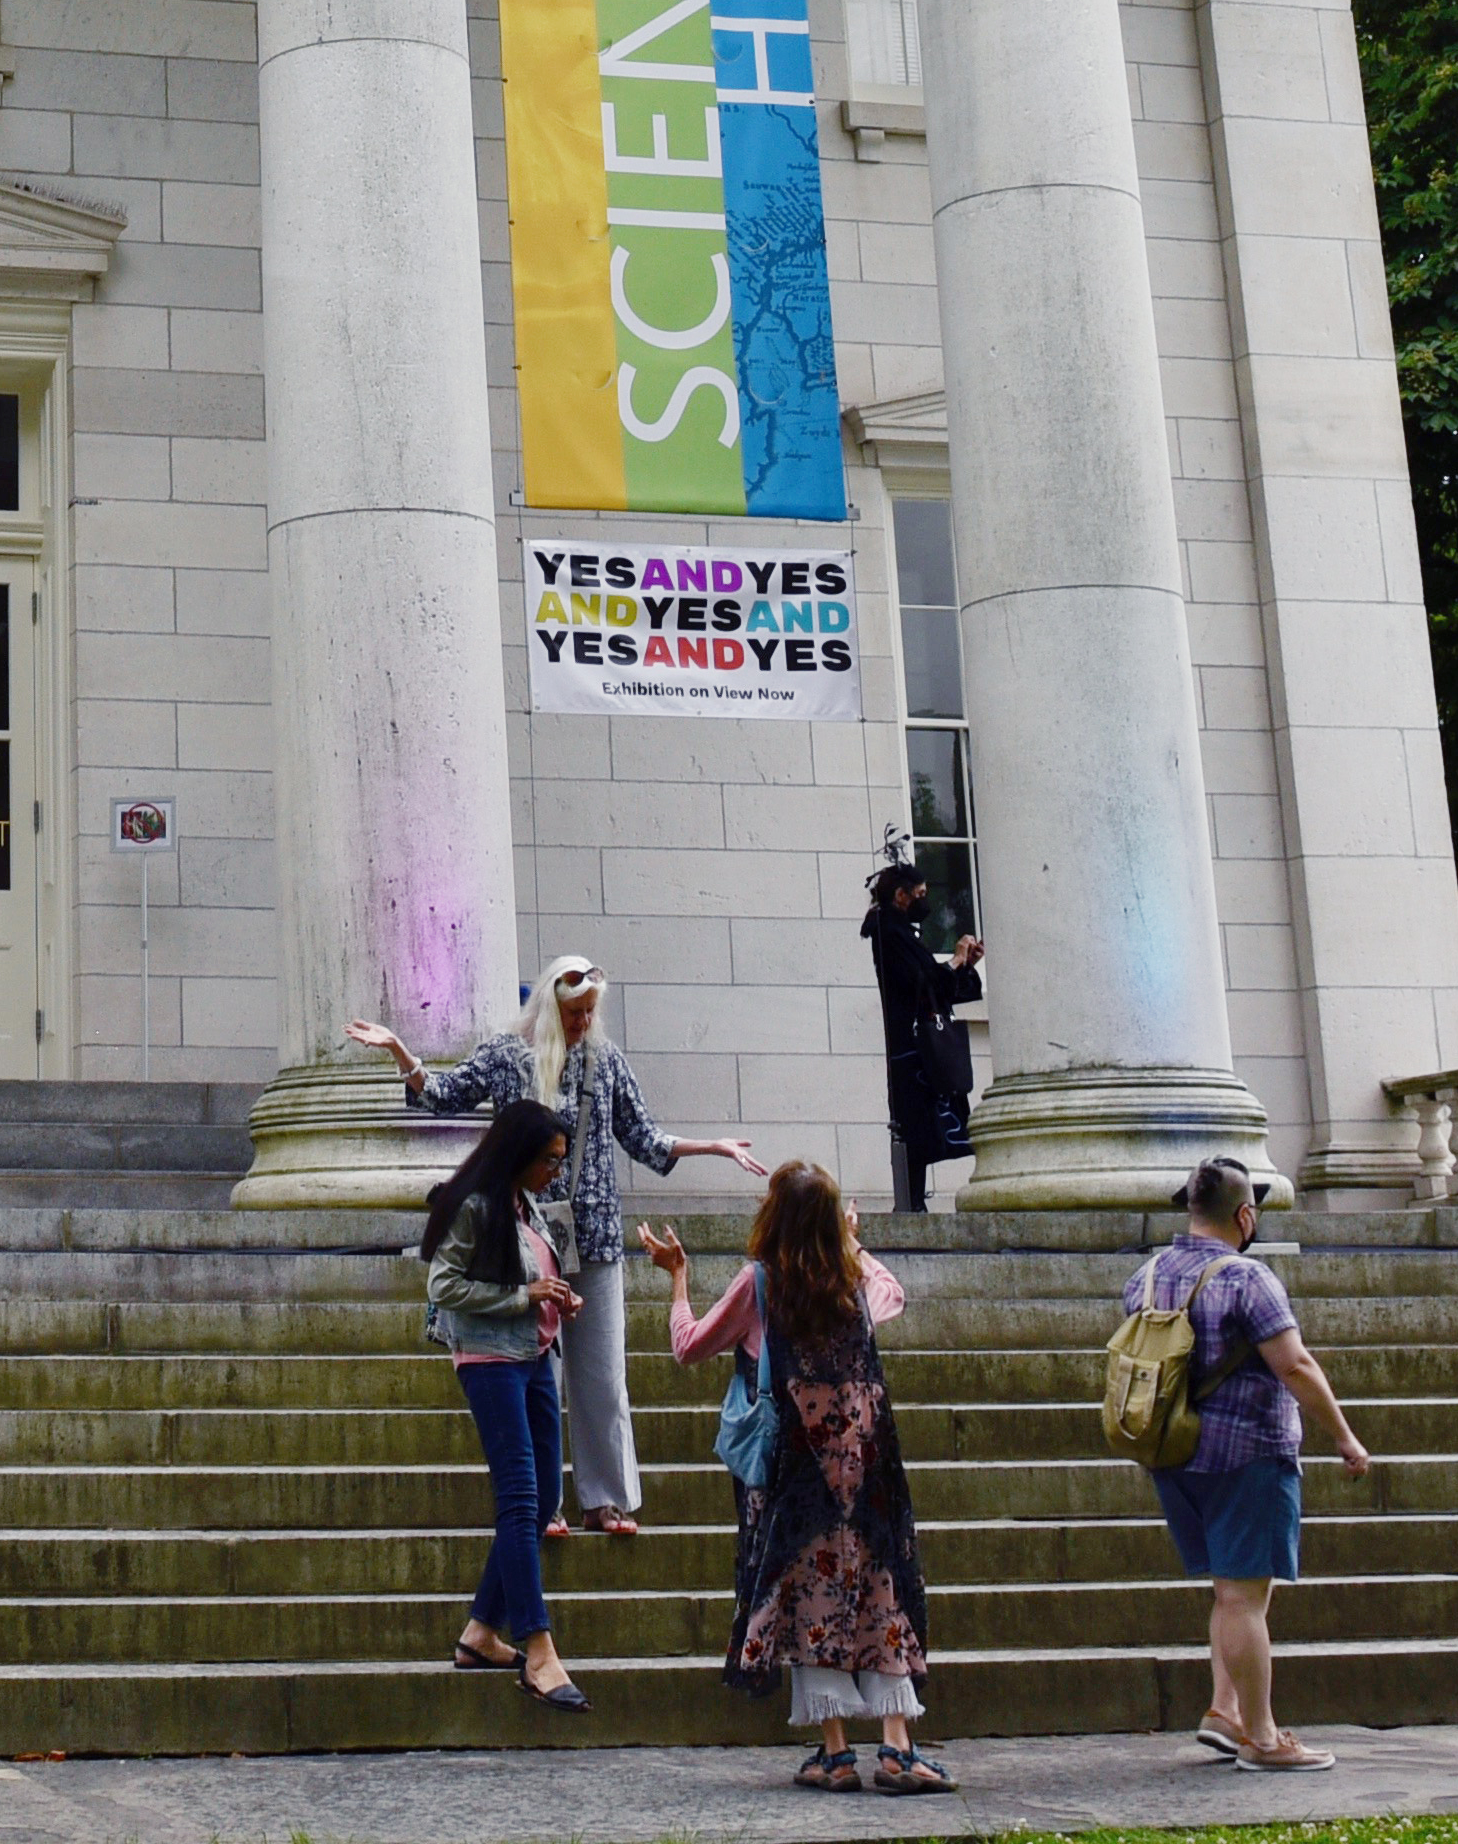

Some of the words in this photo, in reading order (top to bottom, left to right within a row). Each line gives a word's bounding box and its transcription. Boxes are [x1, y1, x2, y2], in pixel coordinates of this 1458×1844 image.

[602, 681, 684, 697] Exhibition
[689, 686, 709, 698] on
[713, 685, 753, 700] View
[758, 687, 795, 701] Now
